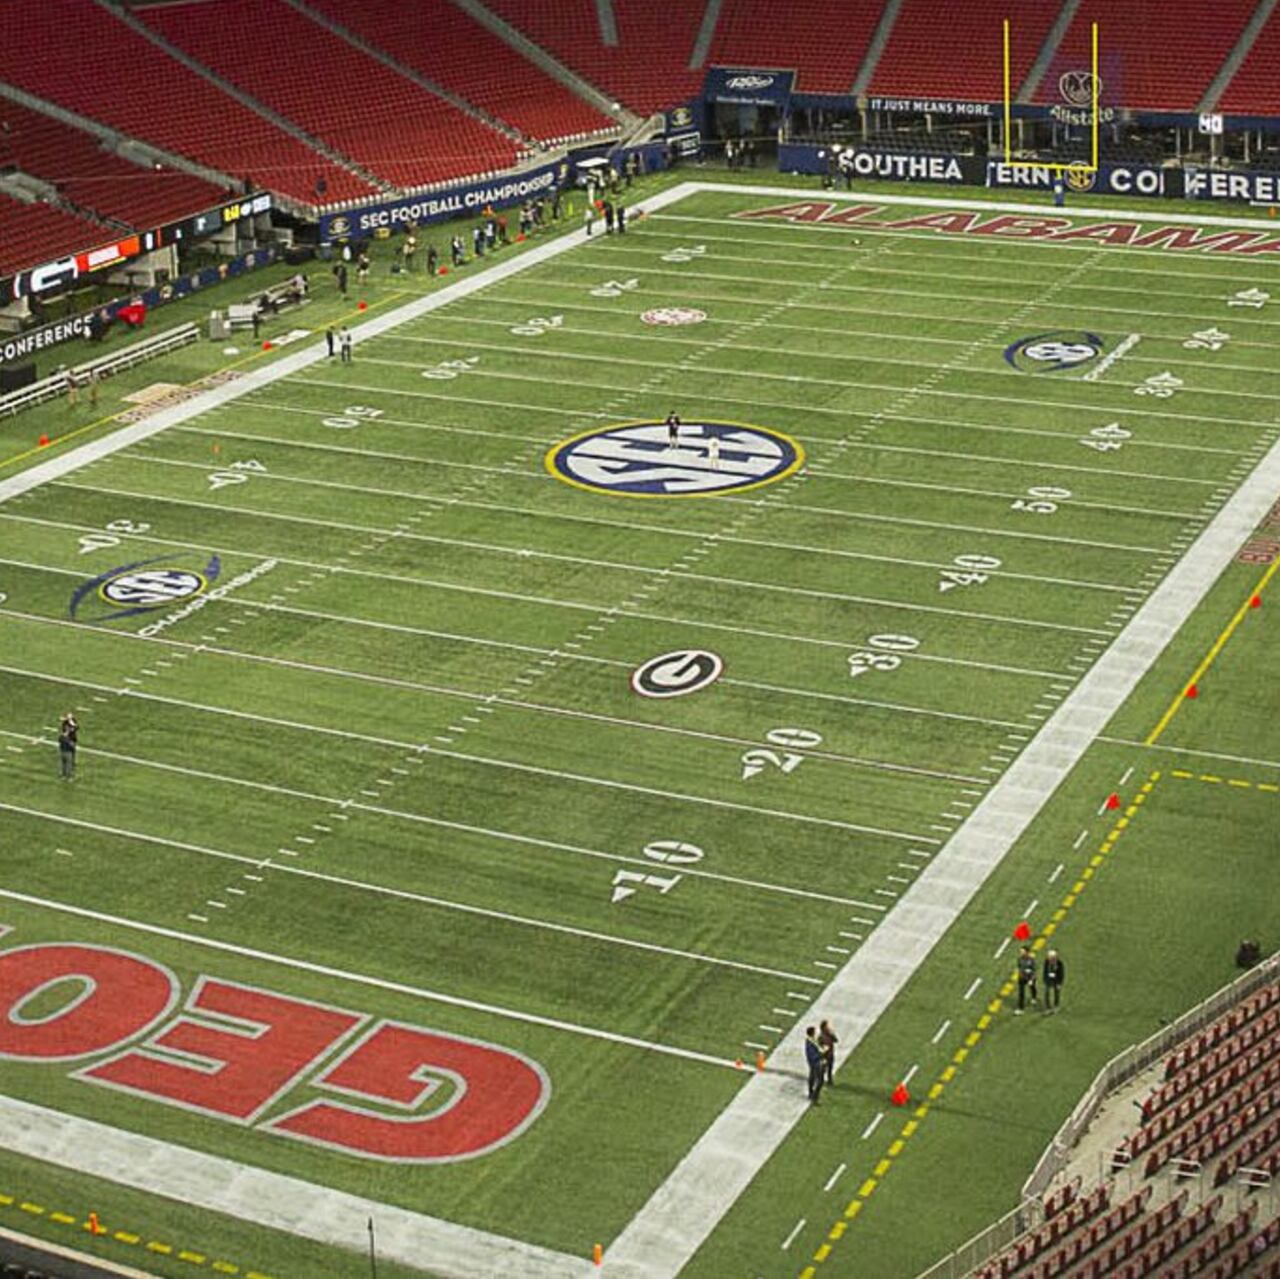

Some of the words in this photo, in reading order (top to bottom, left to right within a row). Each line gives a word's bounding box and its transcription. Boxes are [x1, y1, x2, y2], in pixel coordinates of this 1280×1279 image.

[871, 99, 882, 110] IT
[883, 99, 911, 112] JUST
[913, 101, 953, 114] MEANS
[955, 102, 994, 117] MORE.
[360, 211, 389, 230] SEC
[391, 196, 464, 224] FOOTBALL
[465, 171, 555, 207] CHAMPIONSHIP
[322, 405, 385, 428] 50
[1078, 425, 1133, 452] 40
[207, 458, 268, 485] 40
[566, 424, 783, 493] SEC
[1011, 485, 1072, 514] 50
[78, 519, 151, 550] 30
[949, 554, 1002, 587] 40
[106, 571, 200, 604] SEC
[853, 633, 920, 672] 30
[637, 650, 718, 695] G
[740, 727, 823, 774] 20
[612, 840, 705, 895] 10
